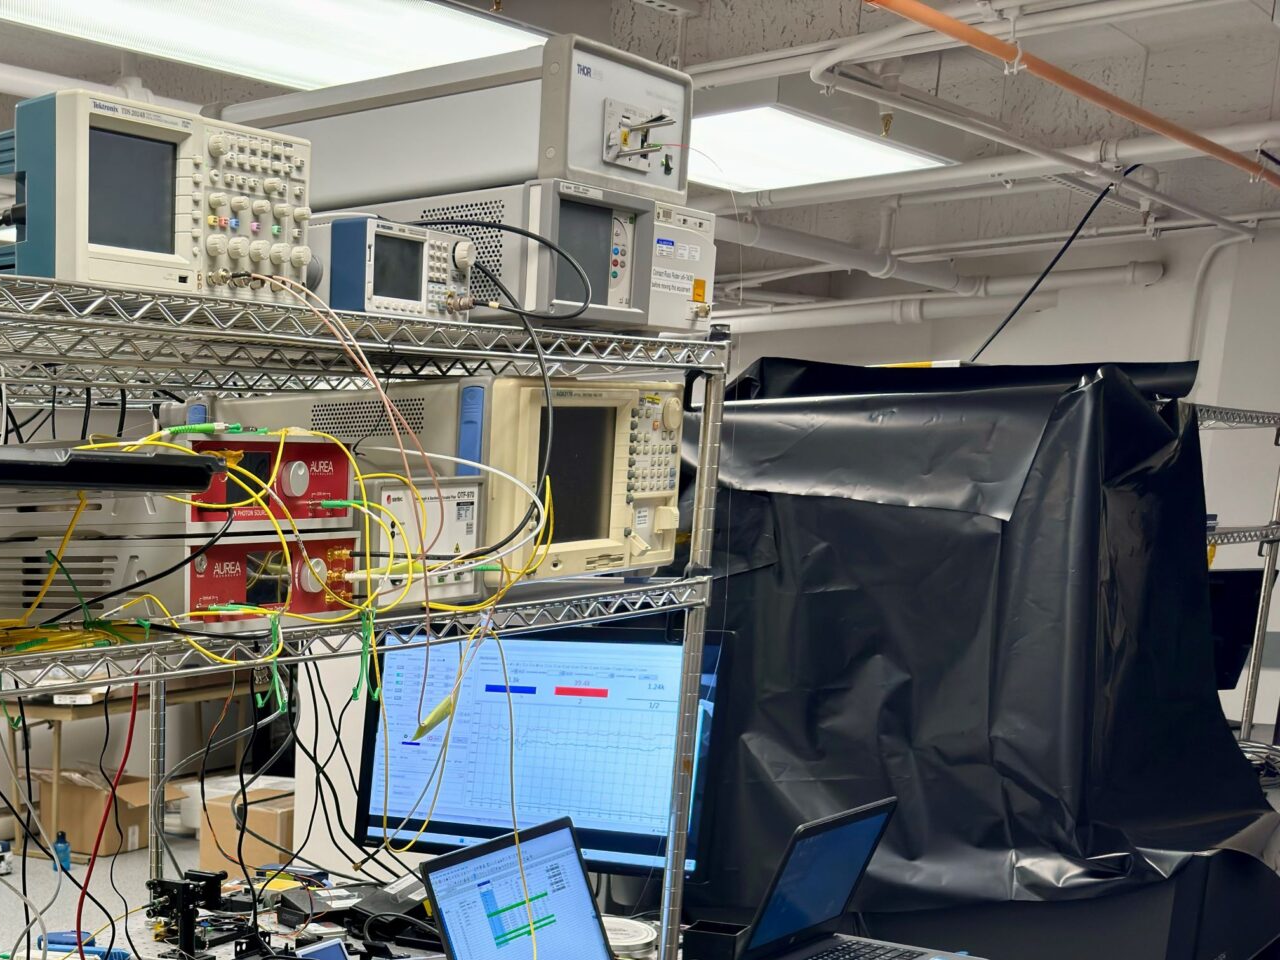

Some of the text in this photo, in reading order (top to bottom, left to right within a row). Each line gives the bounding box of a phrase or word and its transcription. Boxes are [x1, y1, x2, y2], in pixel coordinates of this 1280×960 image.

[93, 101, 119, 113] Tektronix
[310, 460, 334, 473] AUREA
[237, 509, 254, 517] PHOTON
[213, 561, 241, 575] AUREA
